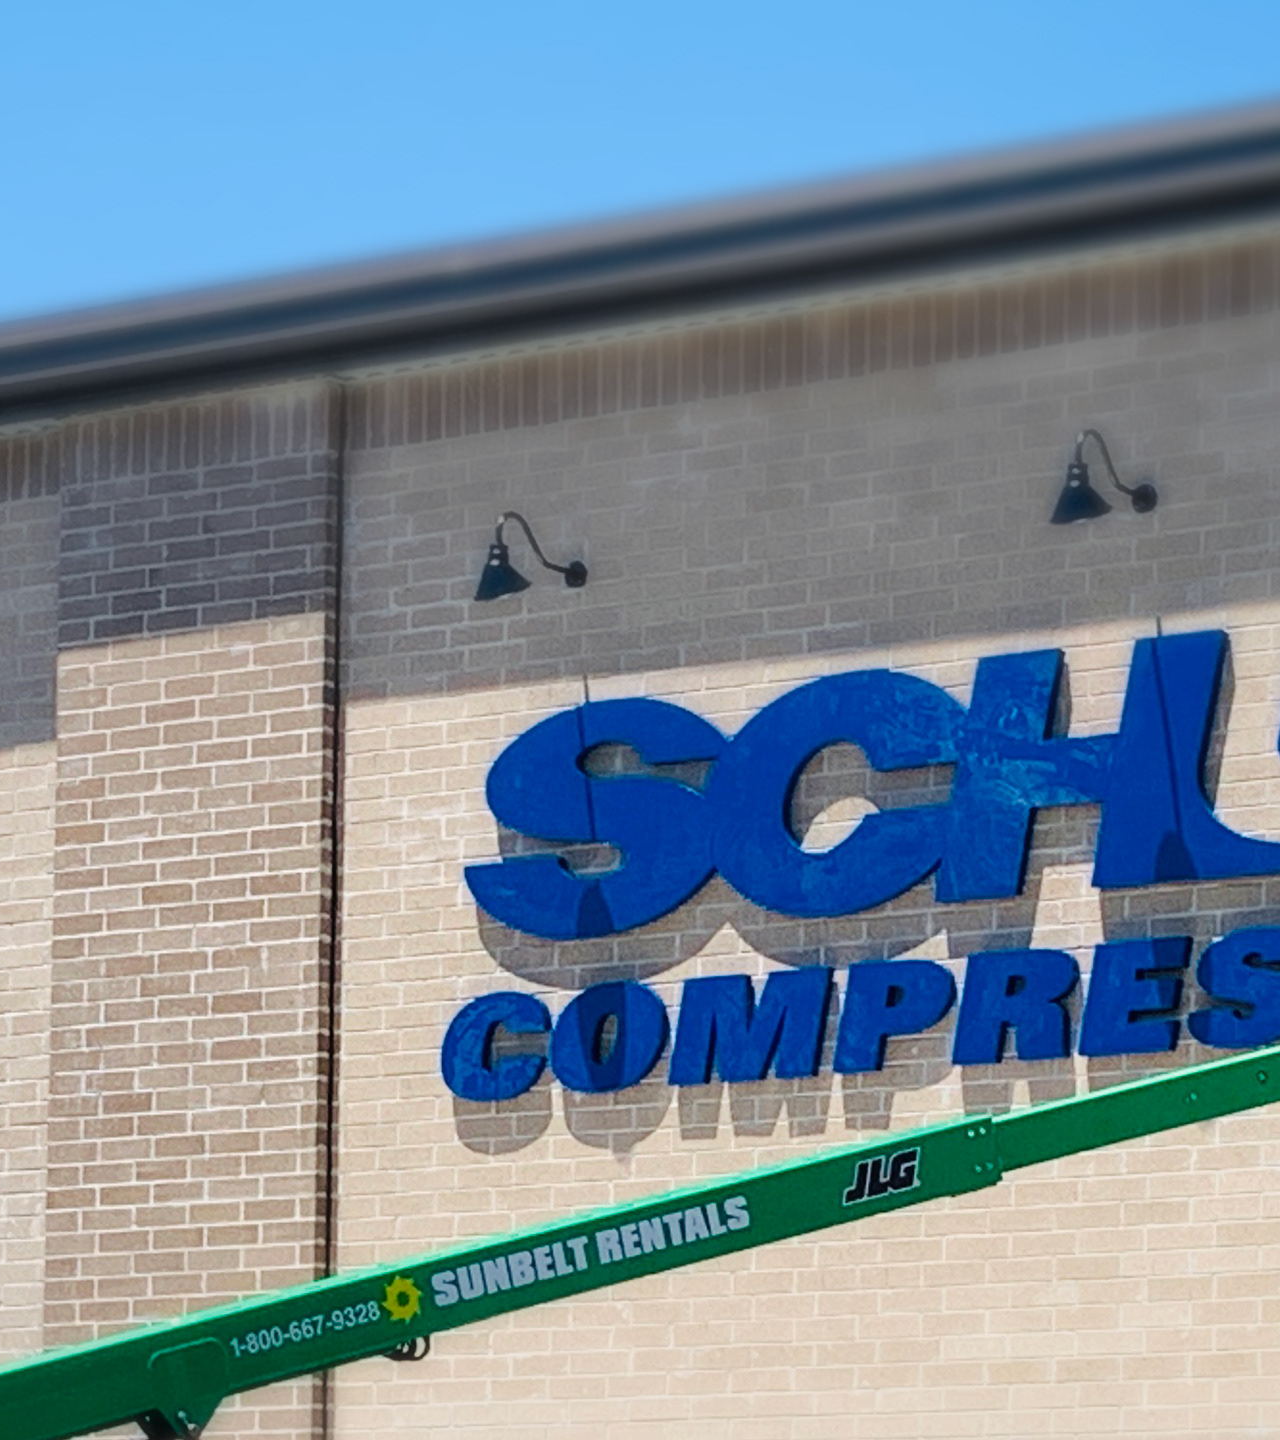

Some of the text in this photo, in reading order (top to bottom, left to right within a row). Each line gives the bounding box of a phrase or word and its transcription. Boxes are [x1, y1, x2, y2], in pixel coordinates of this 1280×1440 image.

[842, 1147, 920, 1206] JLG
[229, 1195, 751, 1358] 1-800-667-9328 SUNBELT RENTALS
